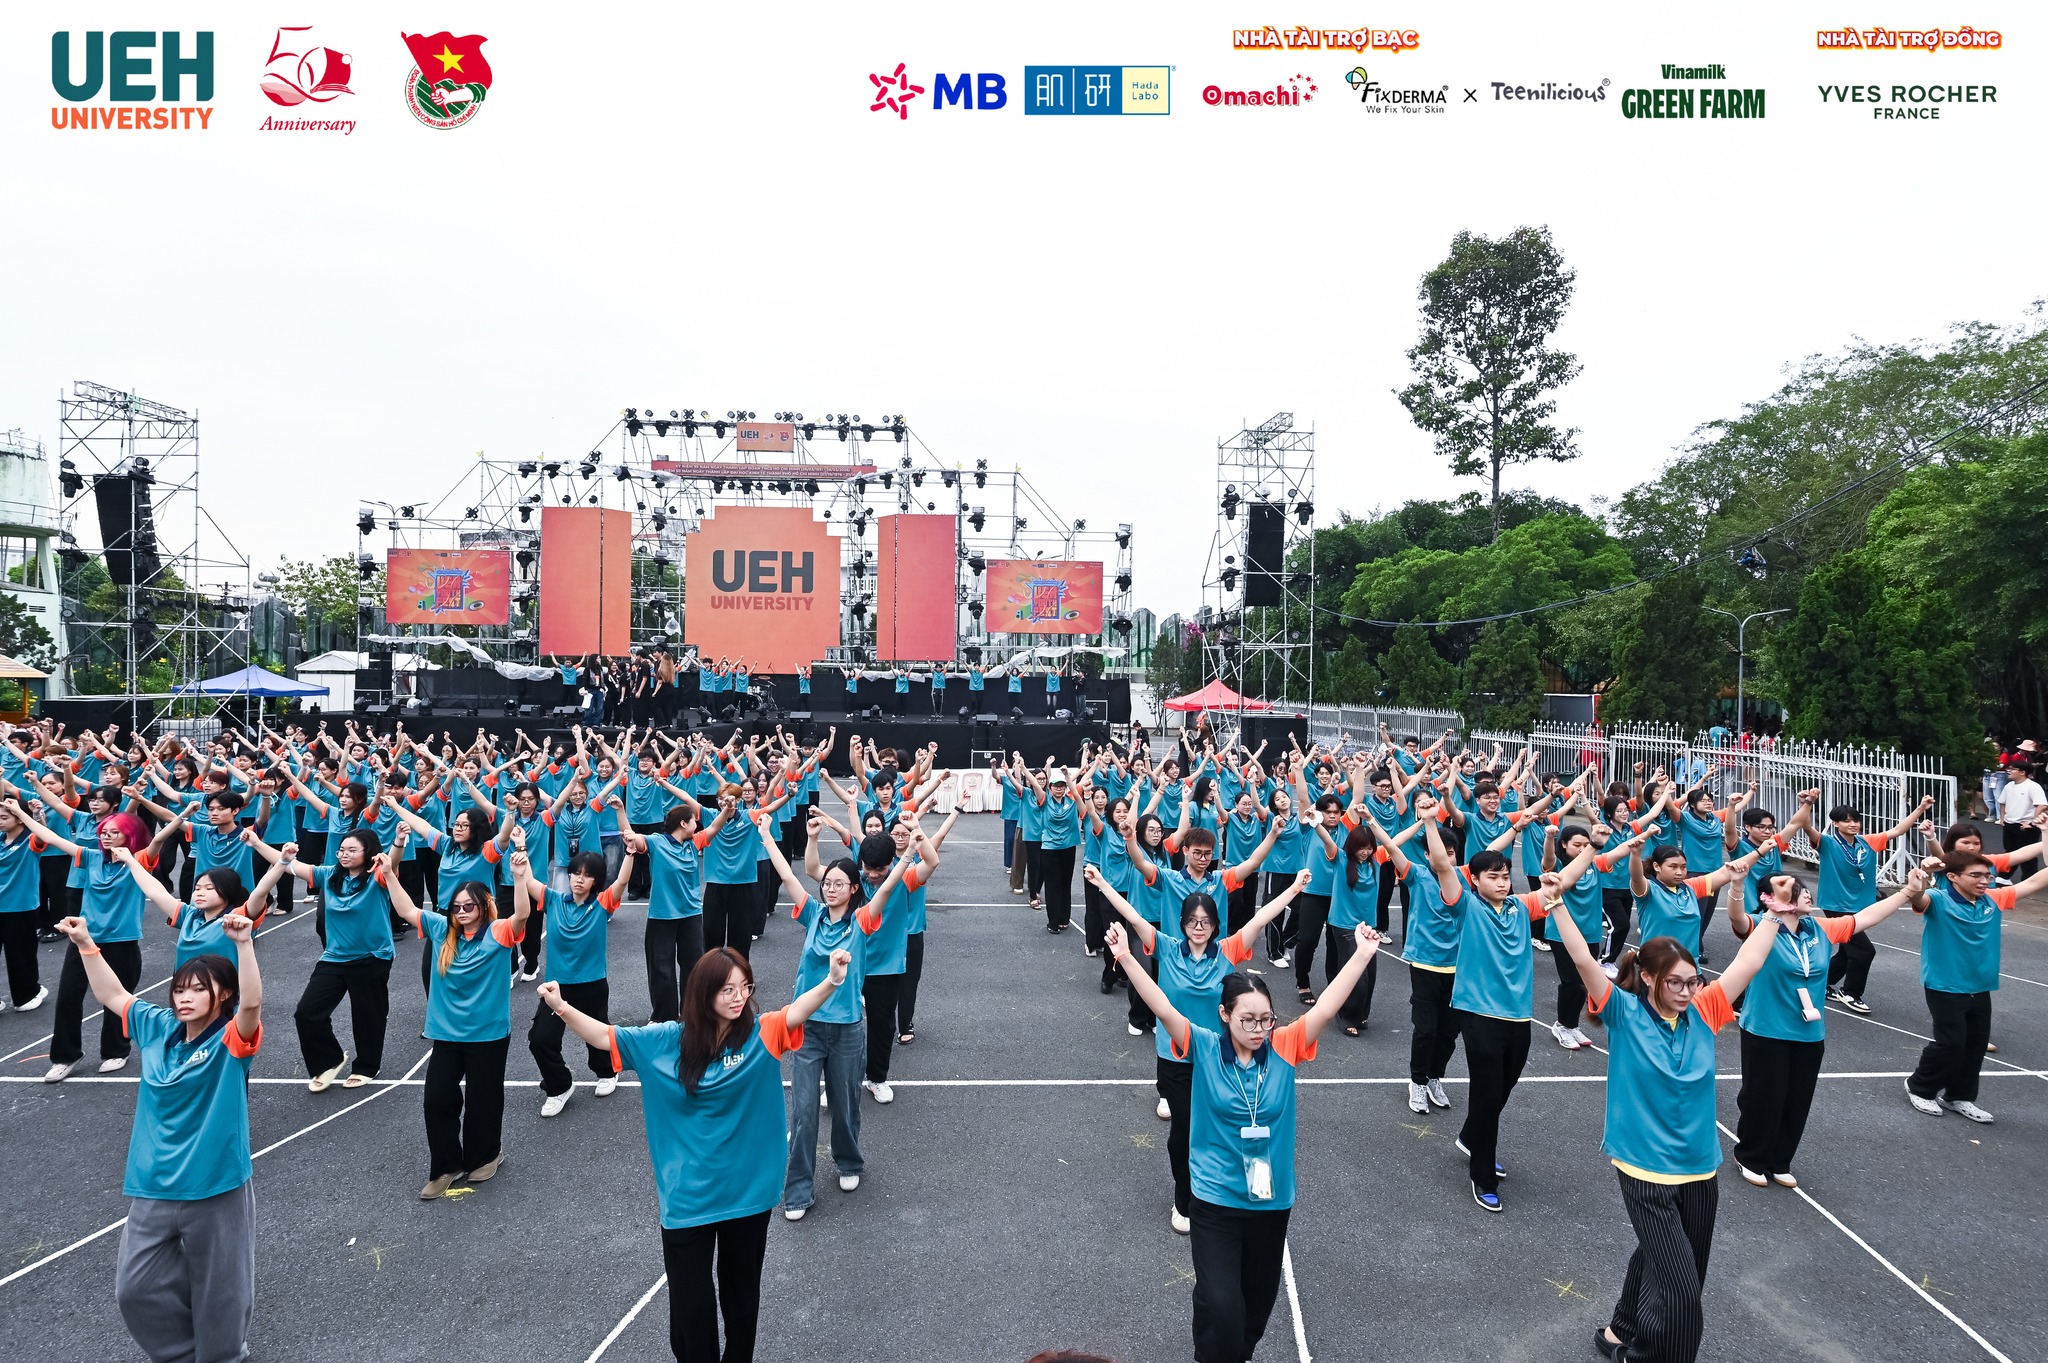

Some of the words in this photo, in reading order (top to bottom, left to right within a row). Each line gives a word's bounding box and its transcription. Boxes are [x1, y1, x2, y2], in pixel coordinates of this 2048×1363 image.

[740, 430, 759, 438] UEH
[712, 550, 814, 593] UEH
[711, 595, 814, 611] UNIVERSITY
[723, 1053, 745, 1067] UEH
